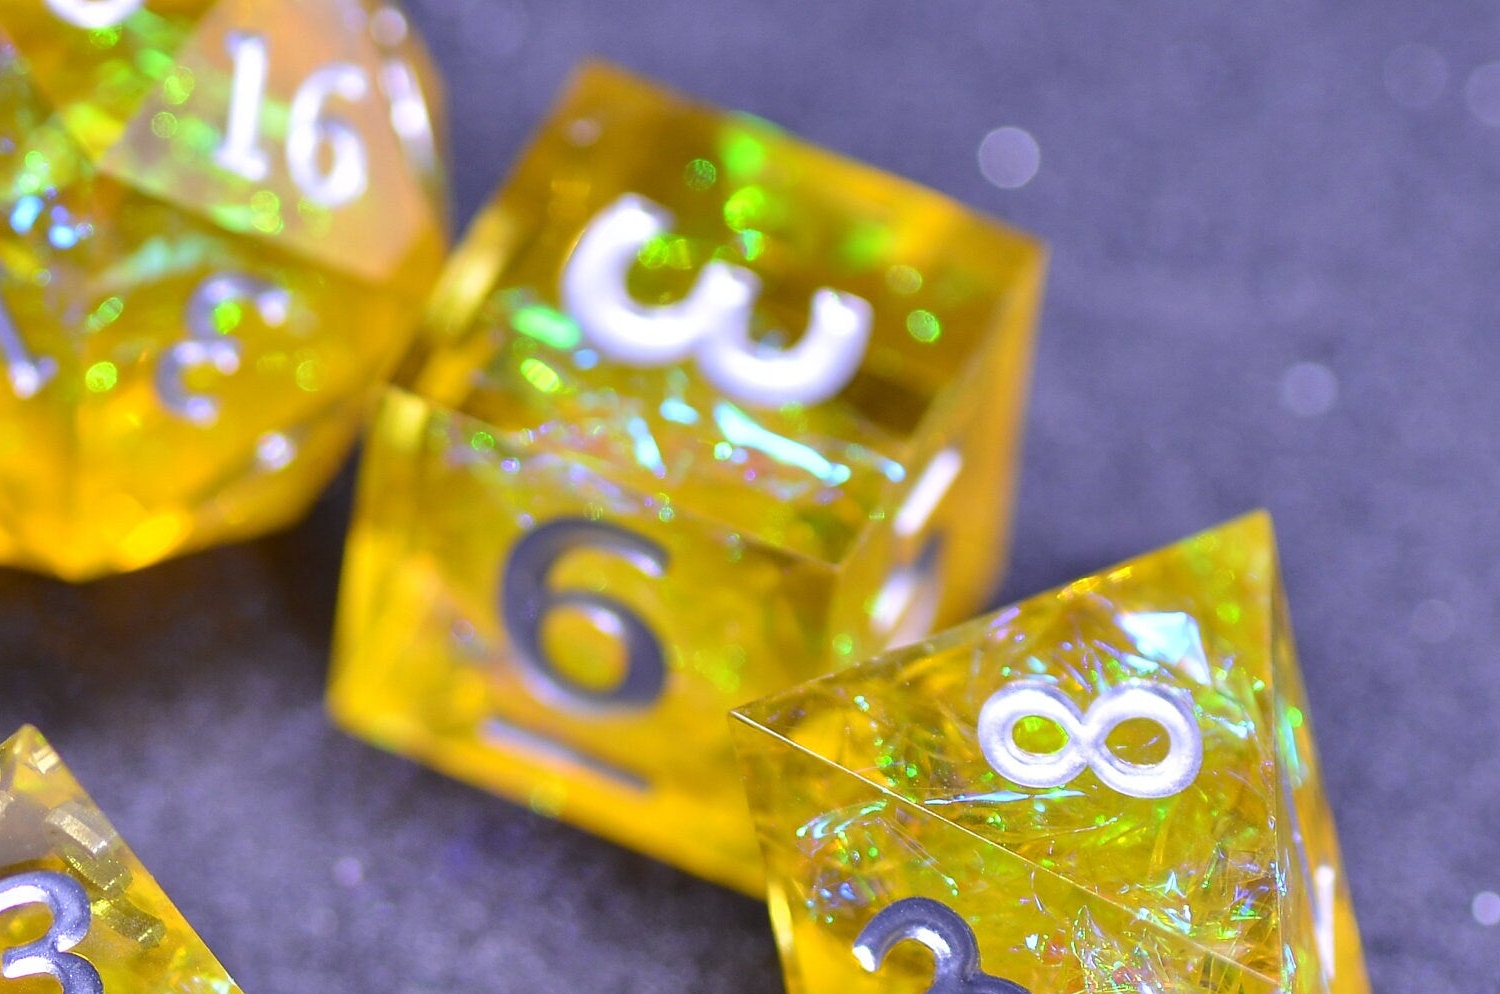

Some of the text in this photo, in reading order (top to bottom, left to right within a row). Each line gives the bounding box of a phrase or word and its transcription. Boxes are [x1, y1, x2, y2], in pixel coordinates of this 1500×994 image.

[215, 28, 370, 208] 16
[561, 192, 874, 408] 3
[503, 514, 672, 719] 6
[977, 679, 1203, 798] 8
